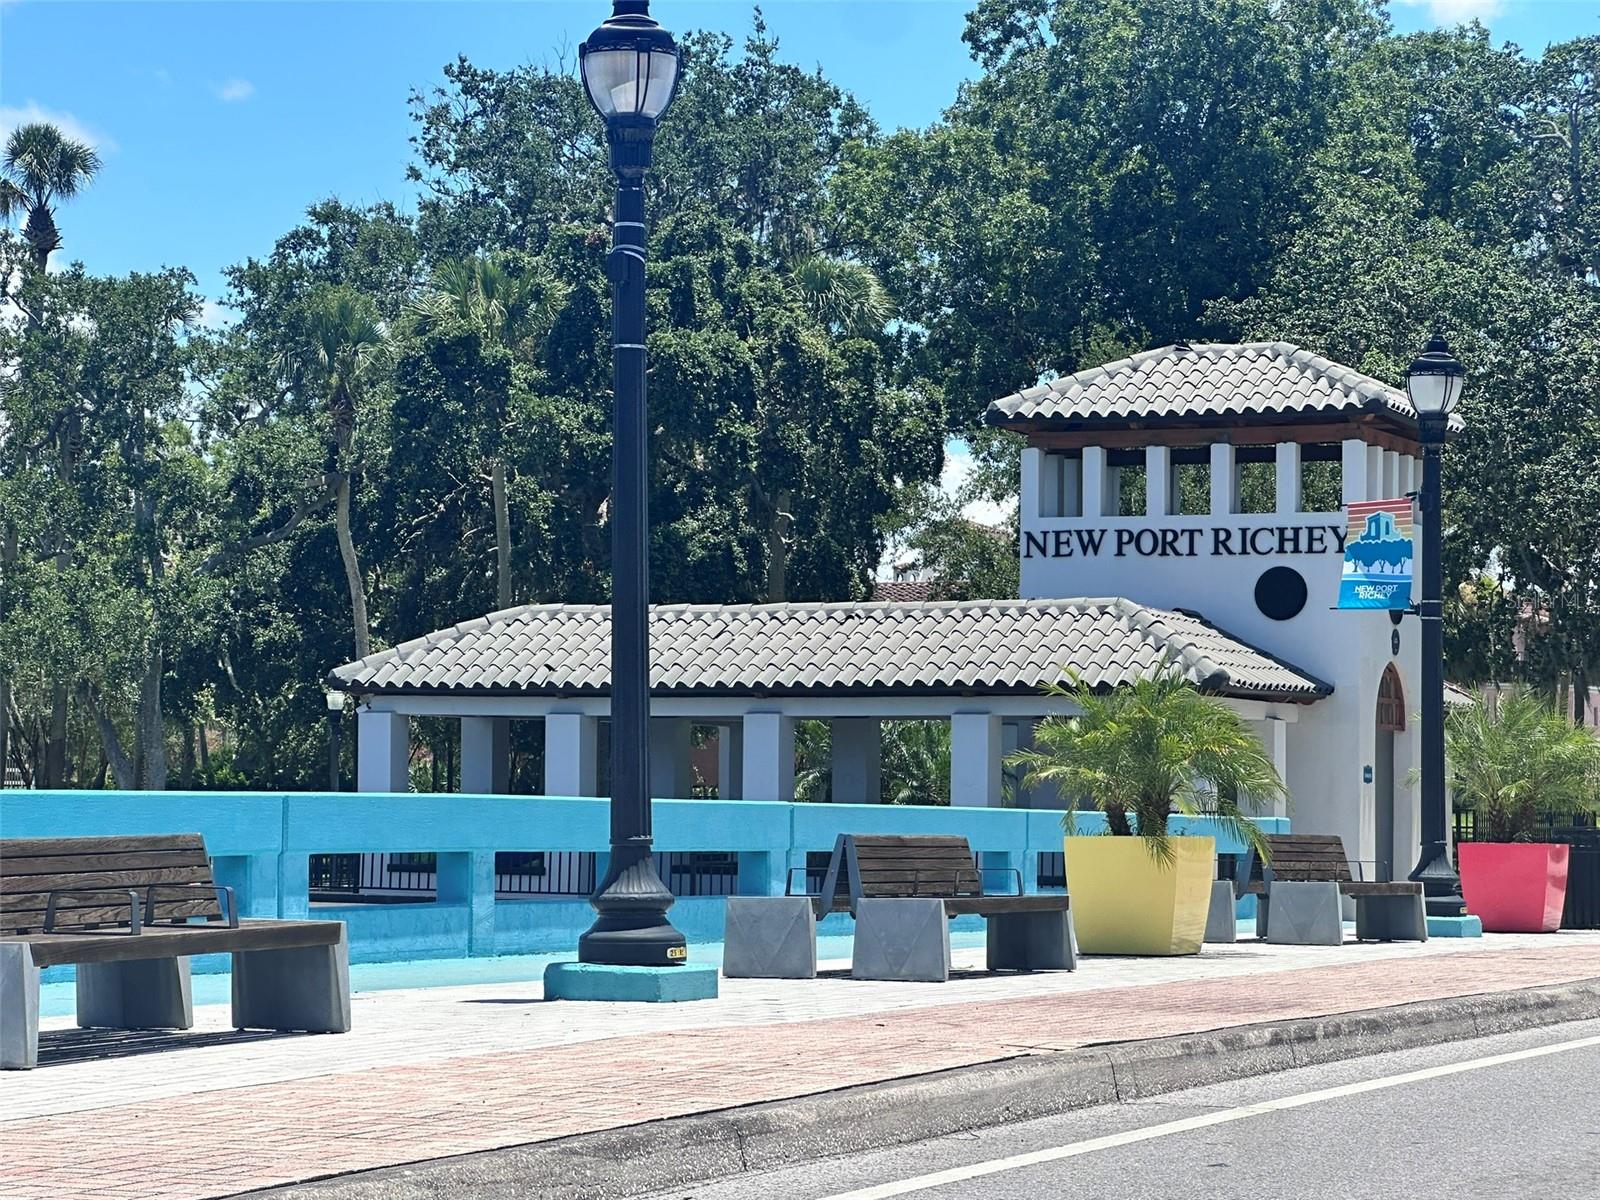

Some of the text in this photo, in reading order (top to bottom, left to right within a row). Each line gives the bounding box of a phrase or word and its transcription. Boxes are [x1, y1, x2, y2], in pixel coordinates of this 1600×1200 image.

[1023, 526, 1347, 558] NEW PORT RICHEY
[1354, 584, 1398, 593] NEW PORT
[1358, 591, 1392, 600] RICHEY
